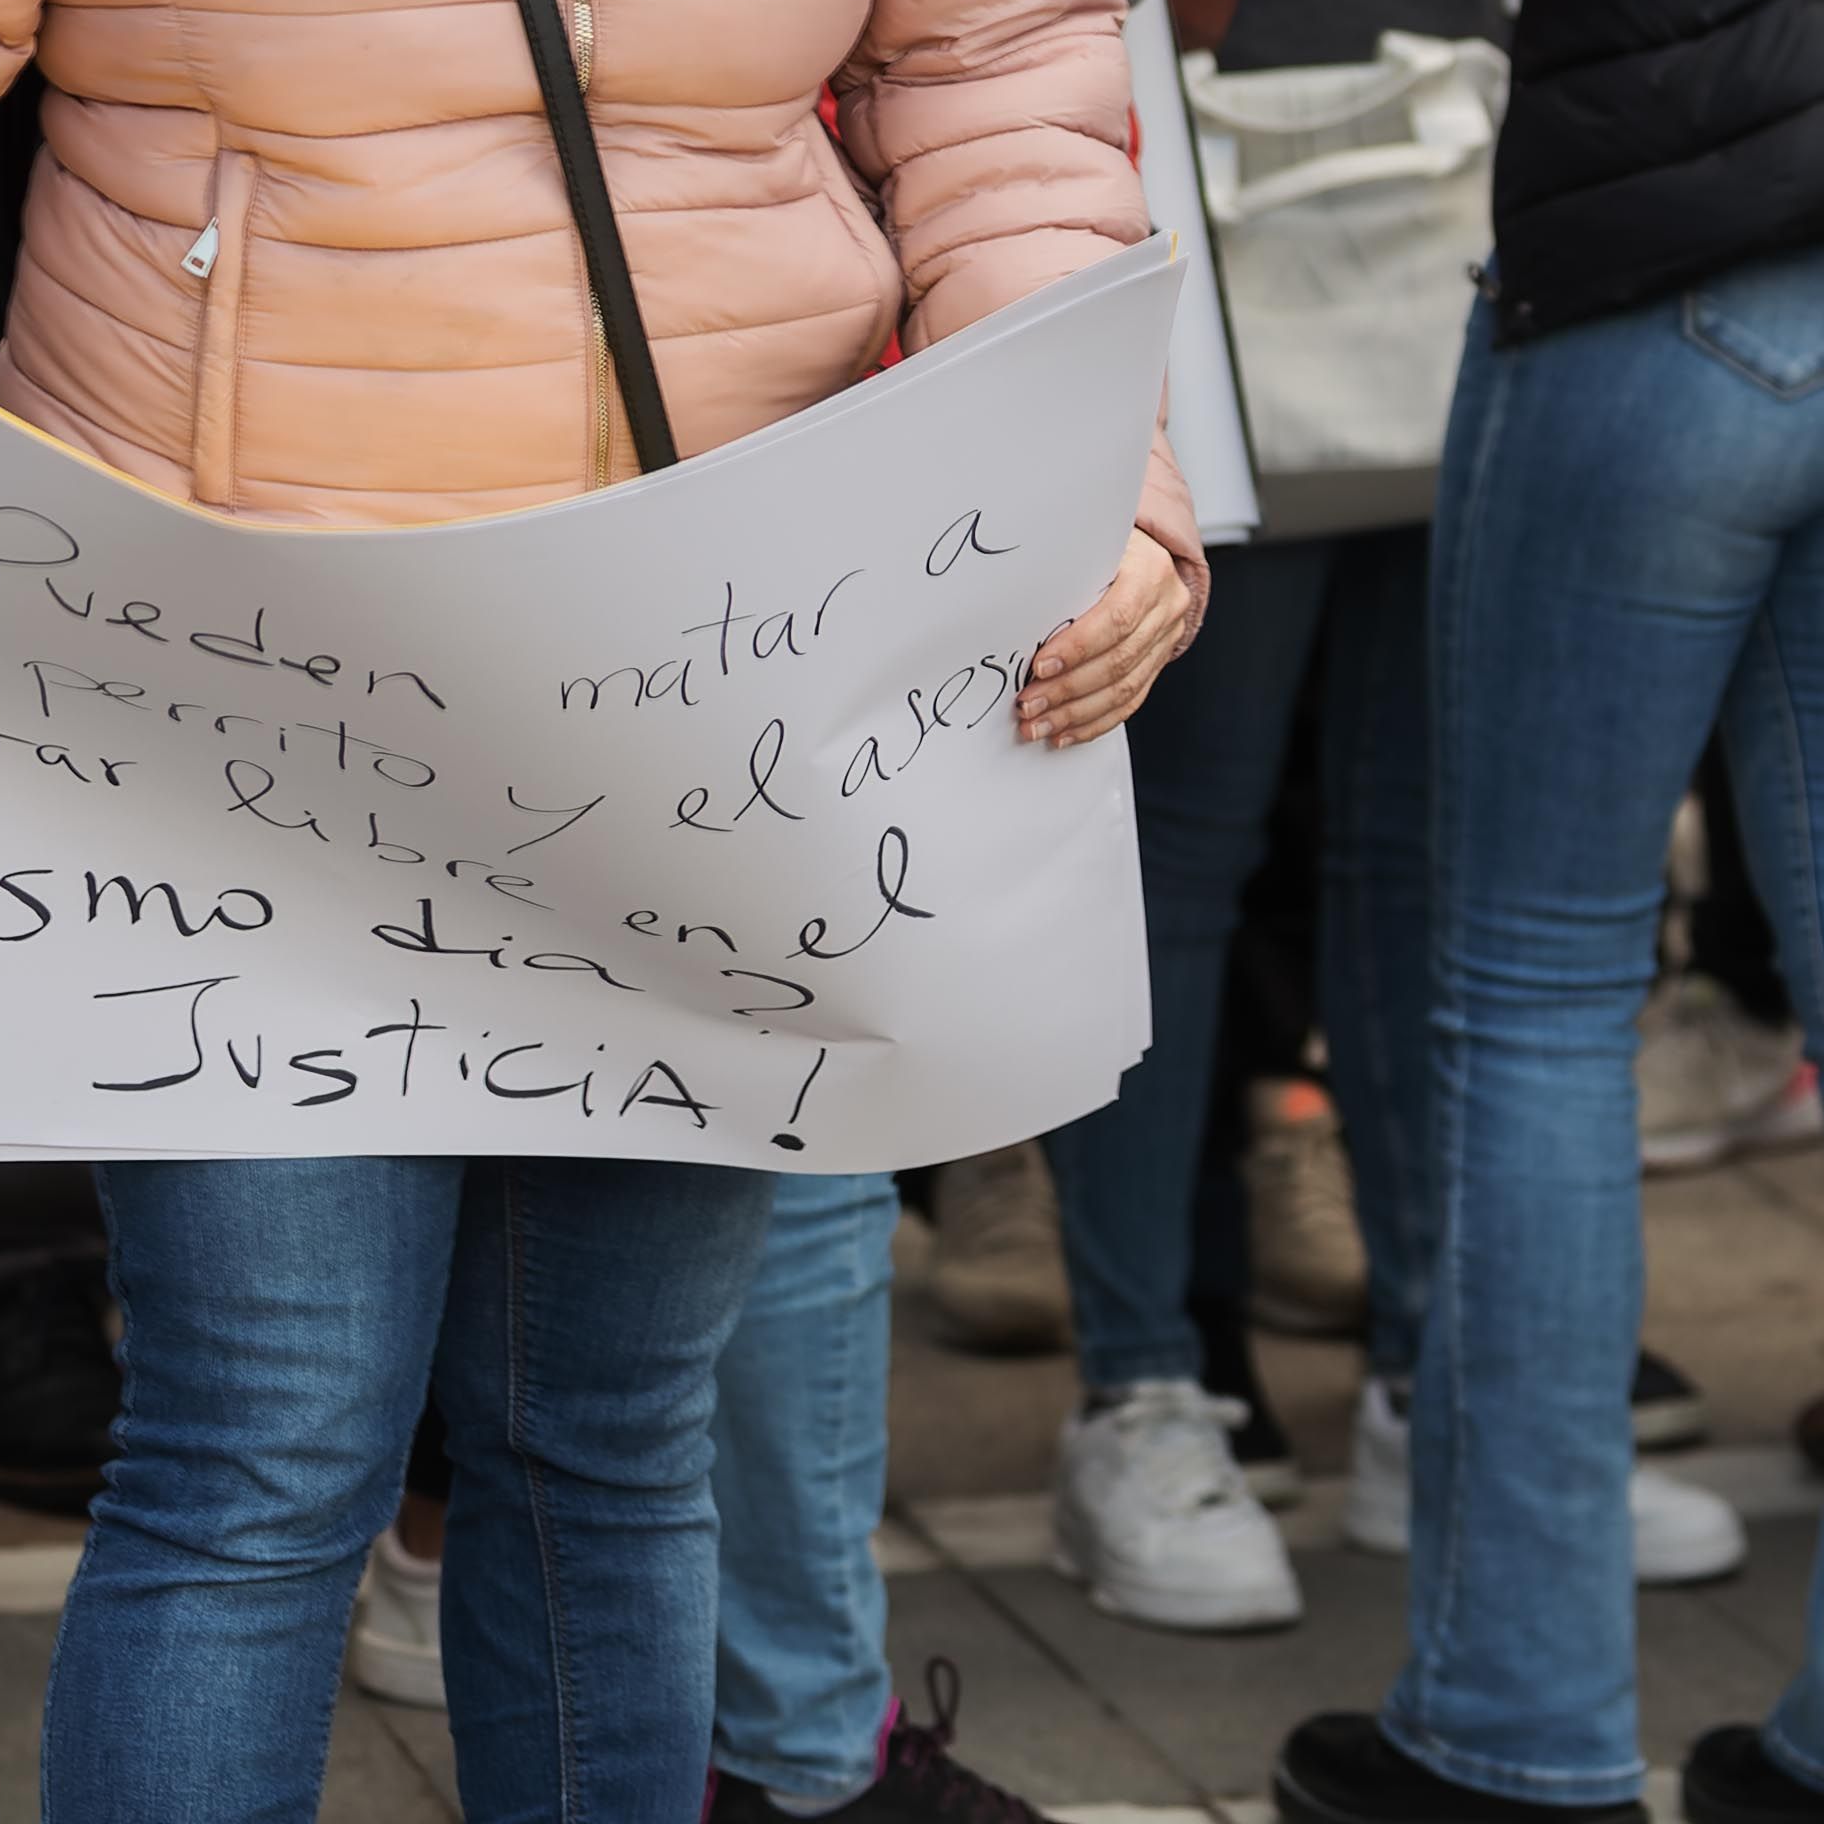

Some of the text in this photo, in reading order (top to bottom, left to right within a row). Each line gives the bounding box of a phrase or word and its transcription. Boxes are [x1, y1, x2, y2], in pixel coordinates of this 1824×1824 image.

[560, 568, 866, 711] matar
[925, 508, 1021, 577] a
[225, 759, 555, 911] libre
[620, 909, 739, 954] en
[784, 825, 937, 960] el
[668, 718, 806, 833] el
